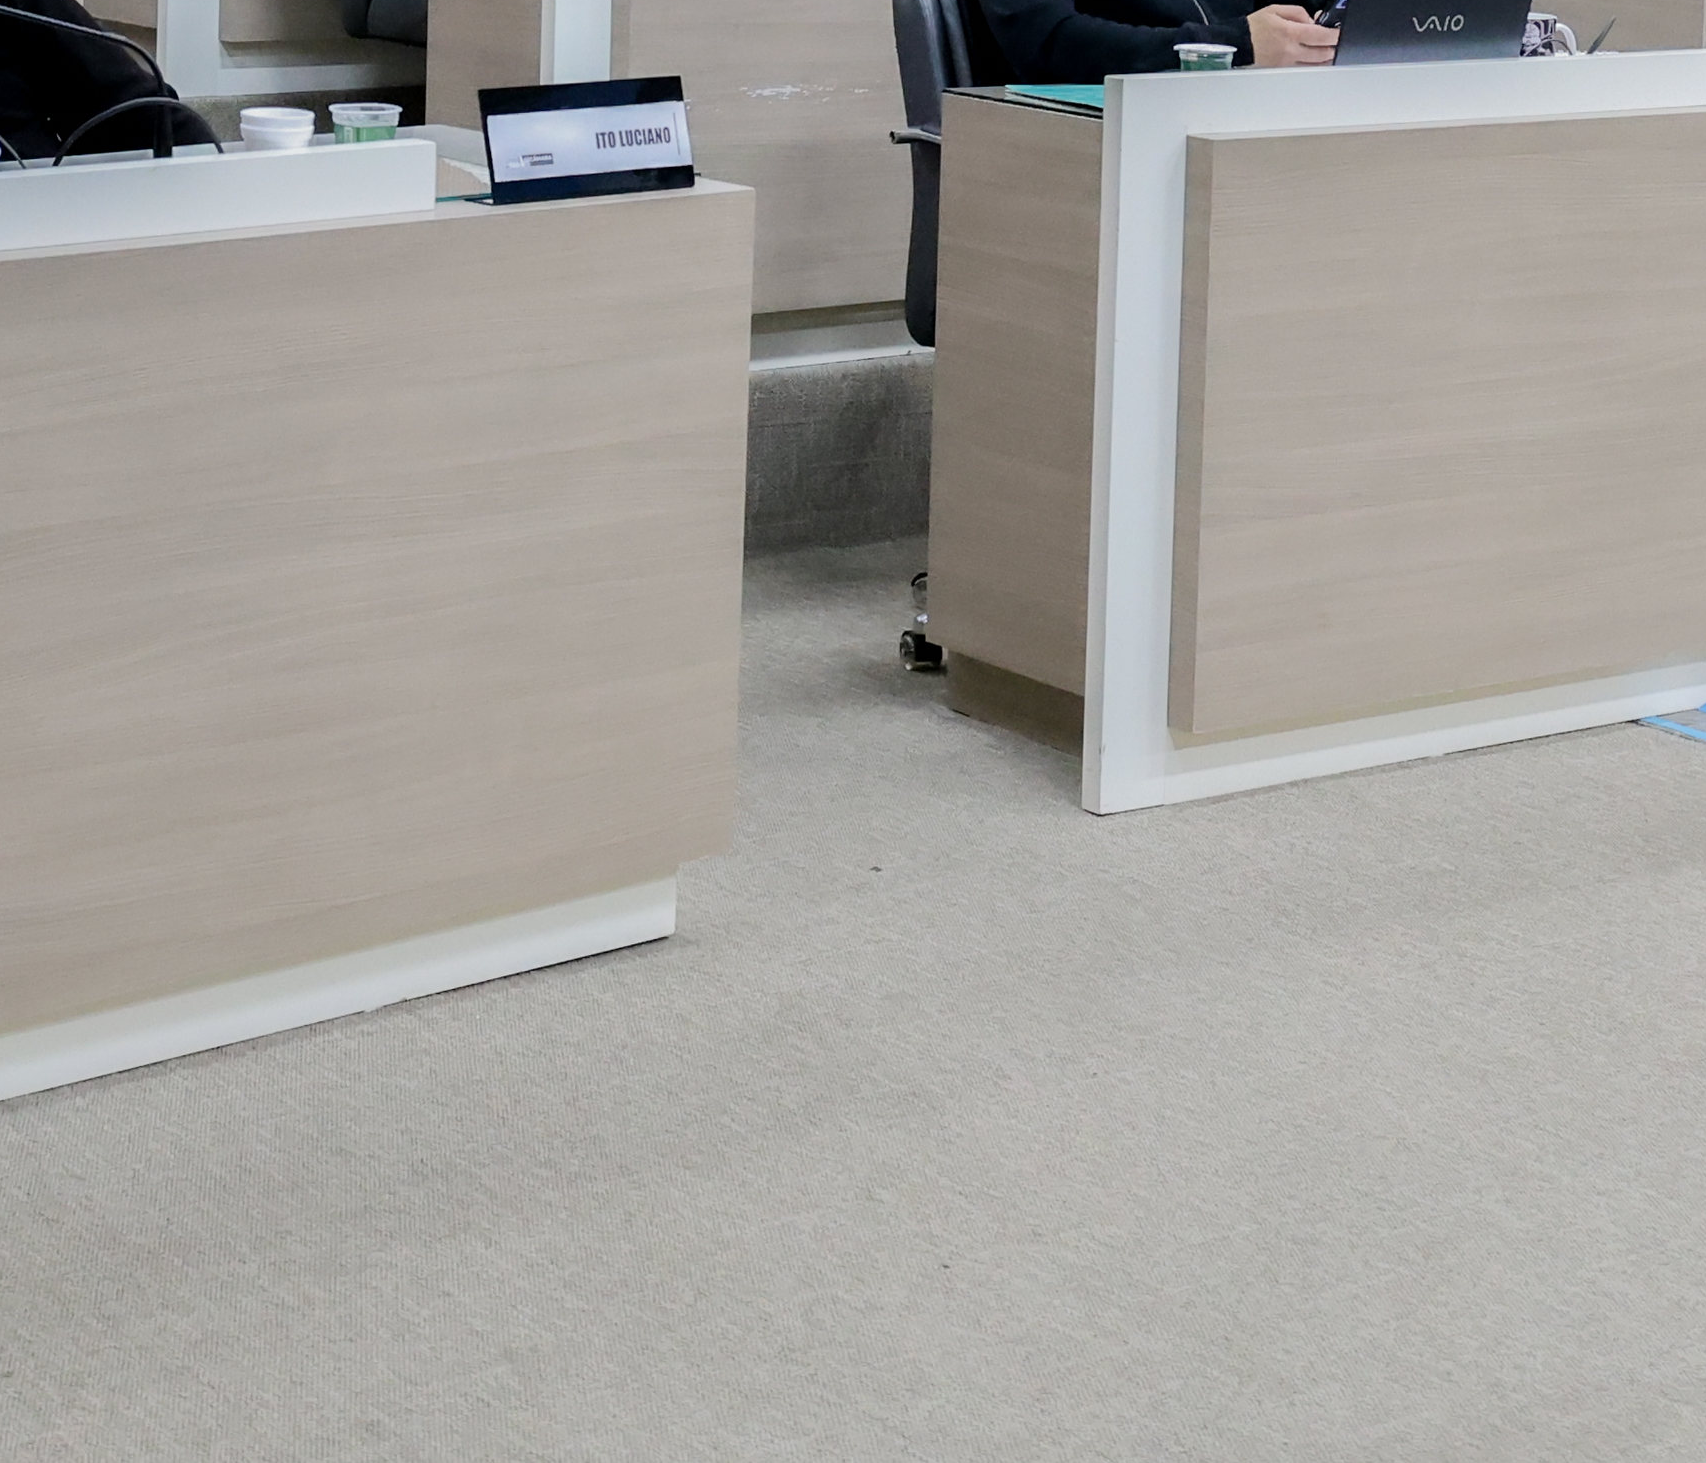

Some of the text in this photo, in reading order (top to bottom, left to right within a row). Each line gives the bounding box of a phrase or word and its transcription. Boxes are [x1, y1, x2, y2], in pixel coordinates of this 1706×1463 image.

[1412, 14, 1464, 32] VAIO
[595, 126, 671, 149] ITO LUCIANO
